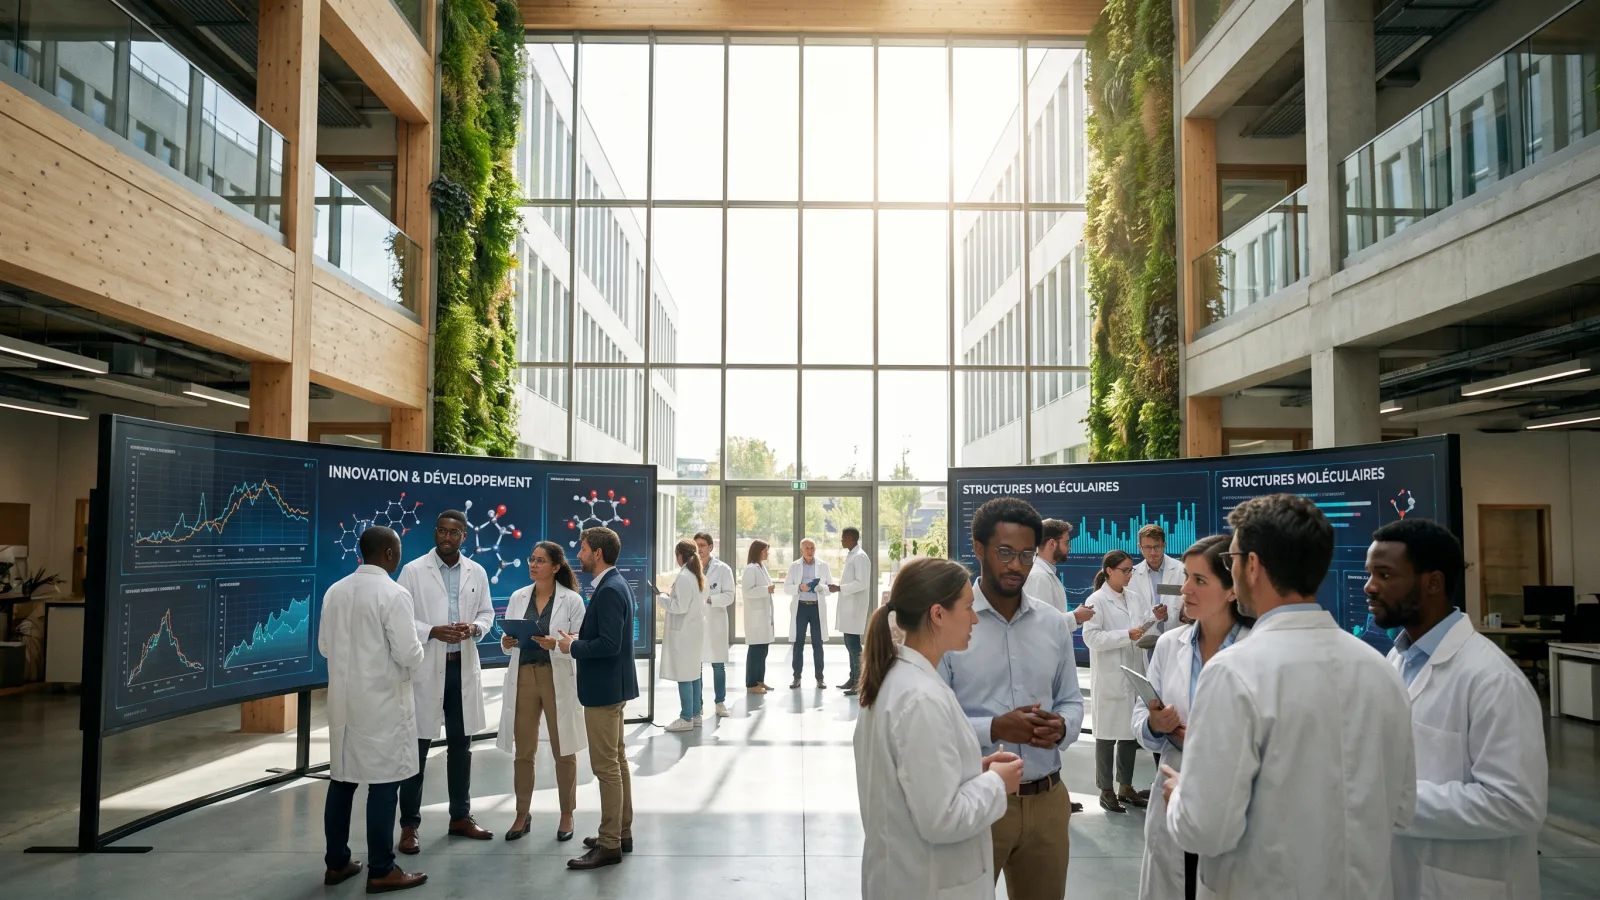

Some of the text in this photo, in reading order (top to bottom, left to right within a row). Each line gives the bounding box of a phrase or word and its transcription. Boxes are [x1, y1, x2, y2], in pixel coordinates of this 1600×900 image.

[328, 464, 533, 489] INNOVATION & DÉVELOPPEMENT
[962, 480, 1120, 495] STRUCTURES MOLÉCULAIRES
[1221, 466, 1386, 488] STRUCTURES MOLÉCULAIRES
